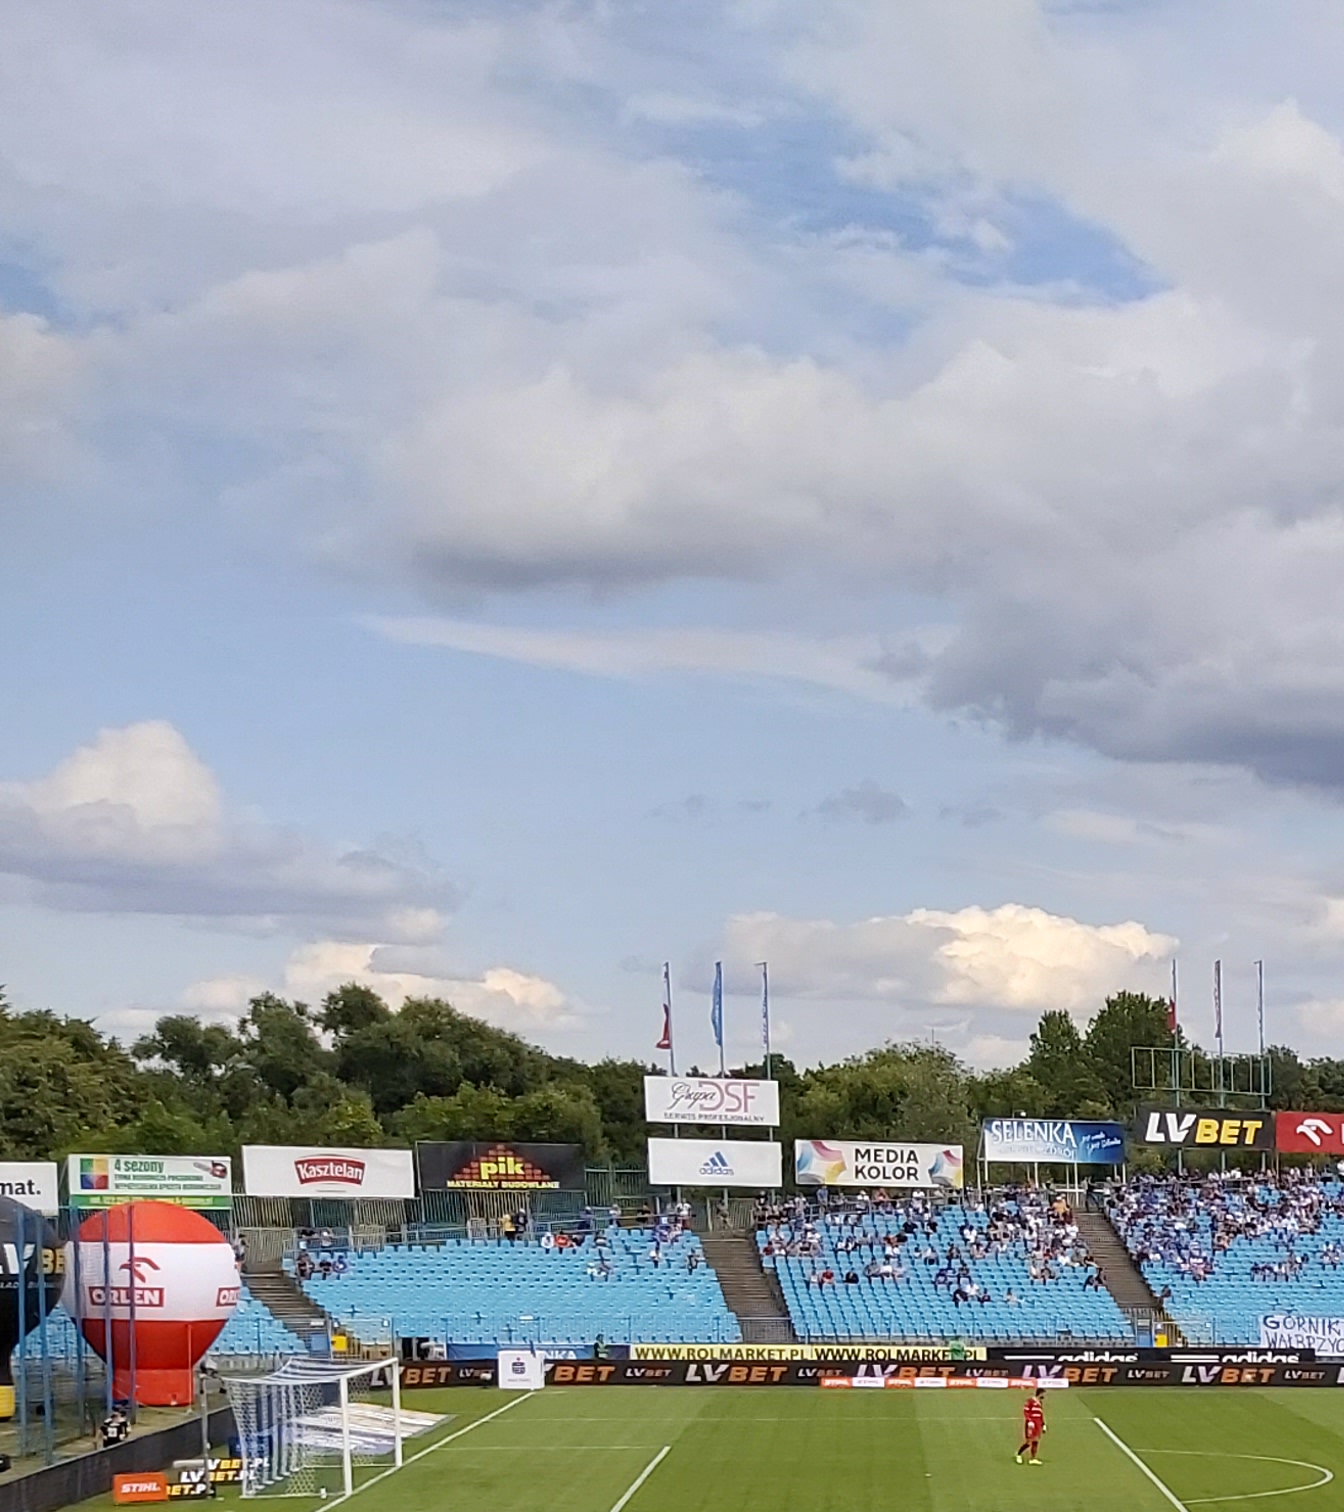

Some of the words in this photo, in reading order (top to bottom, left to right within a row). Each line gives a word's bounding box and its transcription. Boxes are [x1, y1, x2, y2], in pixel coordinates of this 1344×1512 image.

[991, 1120, 1077, 1147] SELENKA
[1145, 1113, 1263, 1145] LVBET
[854, 1149, 919, 1164] MEDIA
[115, 1159, 122, 1171] 4
[124, 1160, 164, 1173] sezony
[298, 1160, 363, 1181] Kasztelan
[480, 1157, 525, 1180] pik
[699, 1165, 734, 1176] adidas
[854, 1165, 919, 1181] KOLOR
[91, 1290, 160, 1305] ORLEN
[635, 1347, 809, 1361] WWW.ROLMARKET.PL
[815, 1347, 978, 1361] WWW.ROLMARKEPL
[544, 1364, 616, 1381] BET
[685, 1364, 787, 1381] LVBET
[1182, 1366, 1275, 1383] LVBET
[121, 1482, 161, 1493] STIHL
